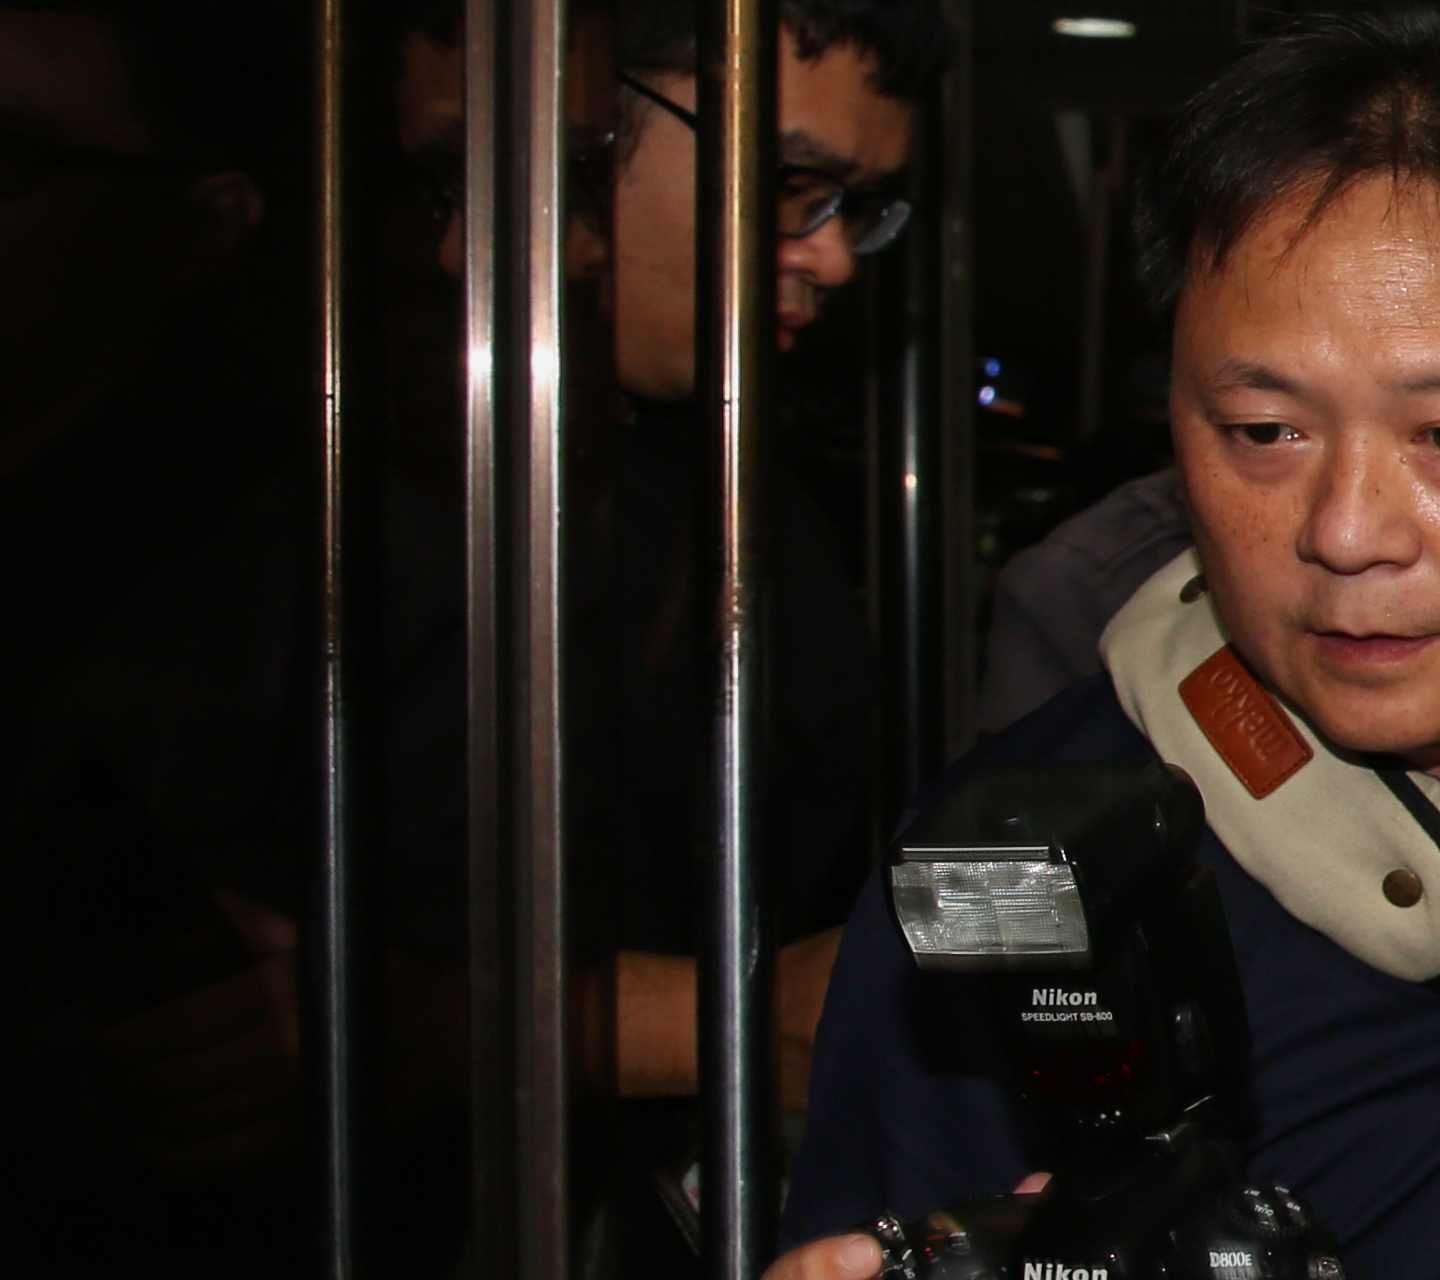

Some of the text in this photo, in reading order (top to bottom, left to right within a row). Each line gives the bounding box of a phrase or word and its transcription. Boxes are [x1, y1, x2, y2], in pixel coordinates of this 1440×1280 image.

[1032, 988, 1098, 1006] Nikon
[1021, 1012, 1078, 1022] SPEEDLIGHT
[1209, 1251, 1253, 1268] D800E
